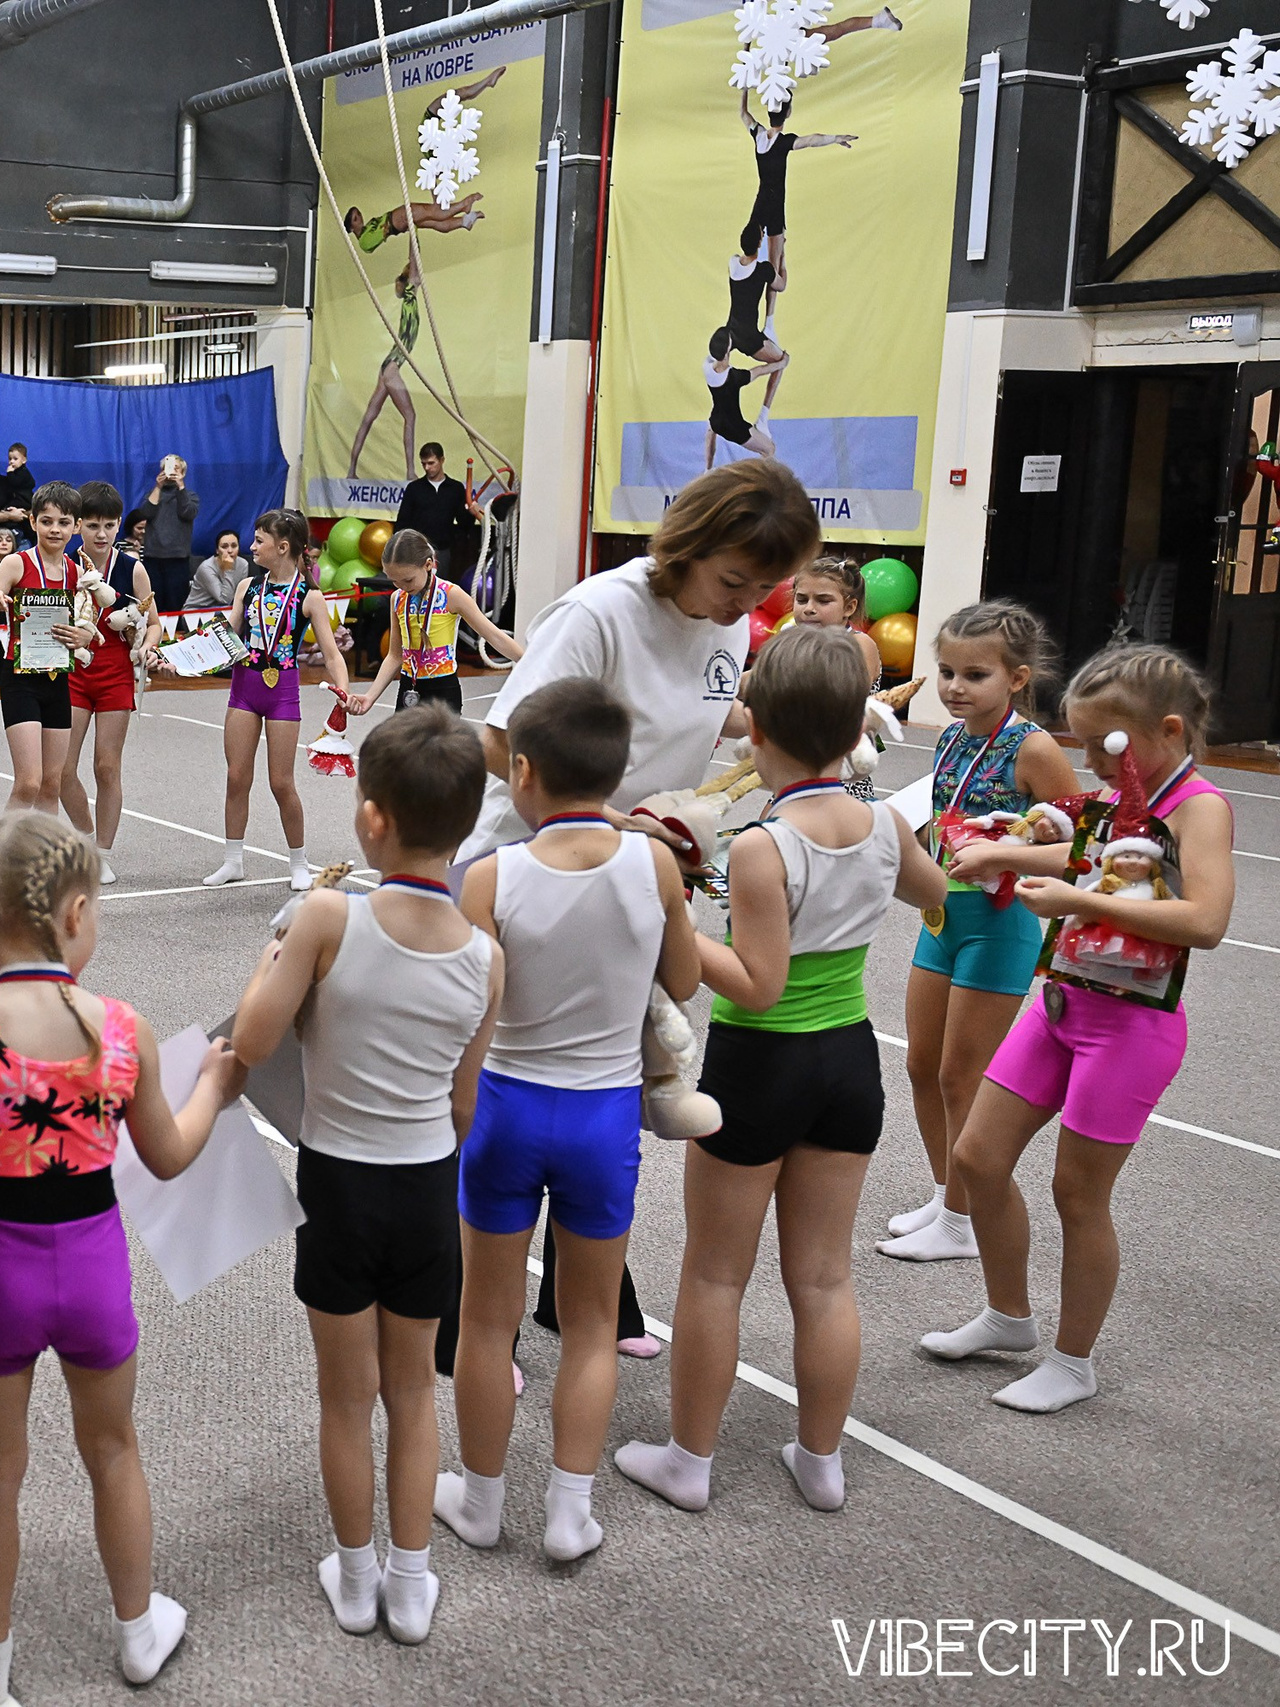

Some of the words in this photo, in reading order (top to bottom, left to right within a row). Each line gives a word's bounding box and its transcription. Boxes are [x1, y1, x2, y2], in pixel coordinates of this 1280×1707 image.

[402, 67, 422, 88] НА
[425, 52, 474, 82] КОВРЕ
[1191, 315, 1233, 328] ВЫХОД
[348, 485, 406, 504] ЖЕНСКА
[22, 594, 66, 606] ГРАМОТА
[212, 621, 238, 656] ГРАМОТА
